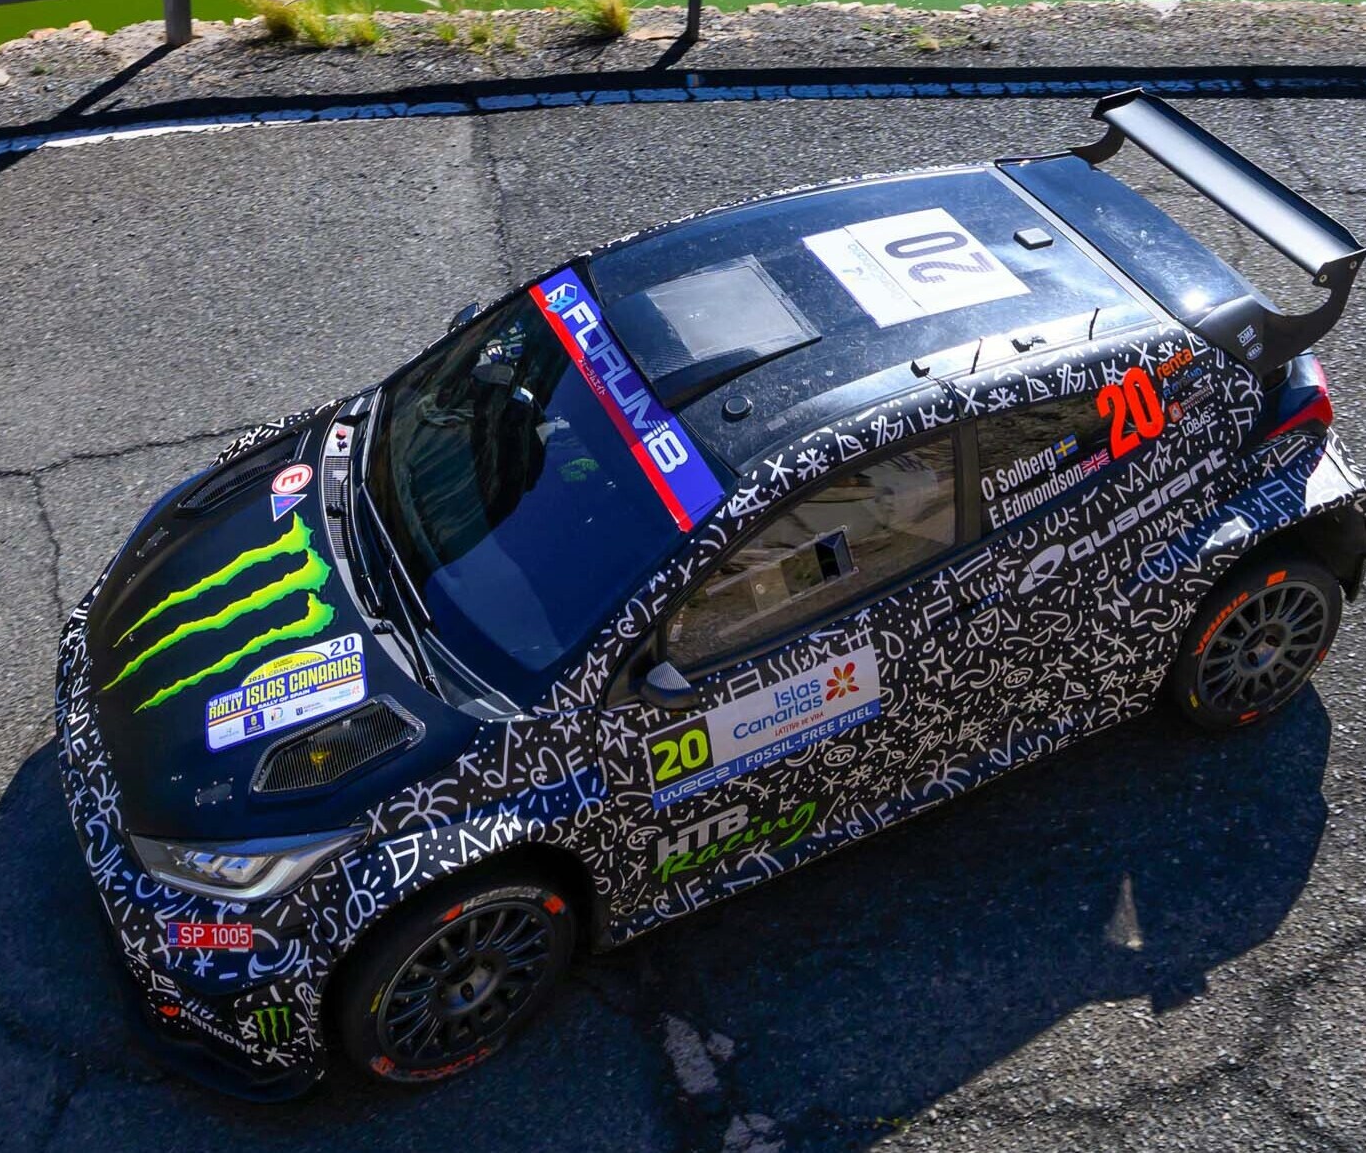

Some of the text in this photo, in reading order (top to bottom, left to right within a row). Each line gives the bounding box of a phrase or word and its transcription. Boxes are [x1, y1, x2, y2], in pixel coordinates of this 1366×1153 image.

[885, 231, 995, 284] 20
[561, 301, 688, 473] FORUM8
[1156, 348, 1194, 380] renta
[1096, 366, 1164, 460] 20
[1181, 411, 1212, 437] LOBAS
[281, 472, 303, 487] E
[980, 444, 1057, 502] O Solberg
[988, 463, 1085, 530] E.Edmondson
[1067, 447, 1227, 562] quadrant
[329, 636, 355, 657] 20
[208, 698, 244, 720] RALLY
[246, 679, 285, 707] ISLAS
[288, 655, 362, 692] CANARIAS
[218, 691, 244, 705] EDITION
[257, 689, 311, 710] RALLY OF SPAIN
[774, 678, 821, 709] Islas
[732, 695, 823, 740] Canarias
[810, 711, 825, 722] VIDA
[651, 728, 709, 782] 20
[659, 706, 873, 803] WRC2 FOSSIL-FREE FUEL
[652, 801, 817, 883] Racing
[657, 804, 749, 867] HTB
[180, 926, 250, 945] SP 1005
